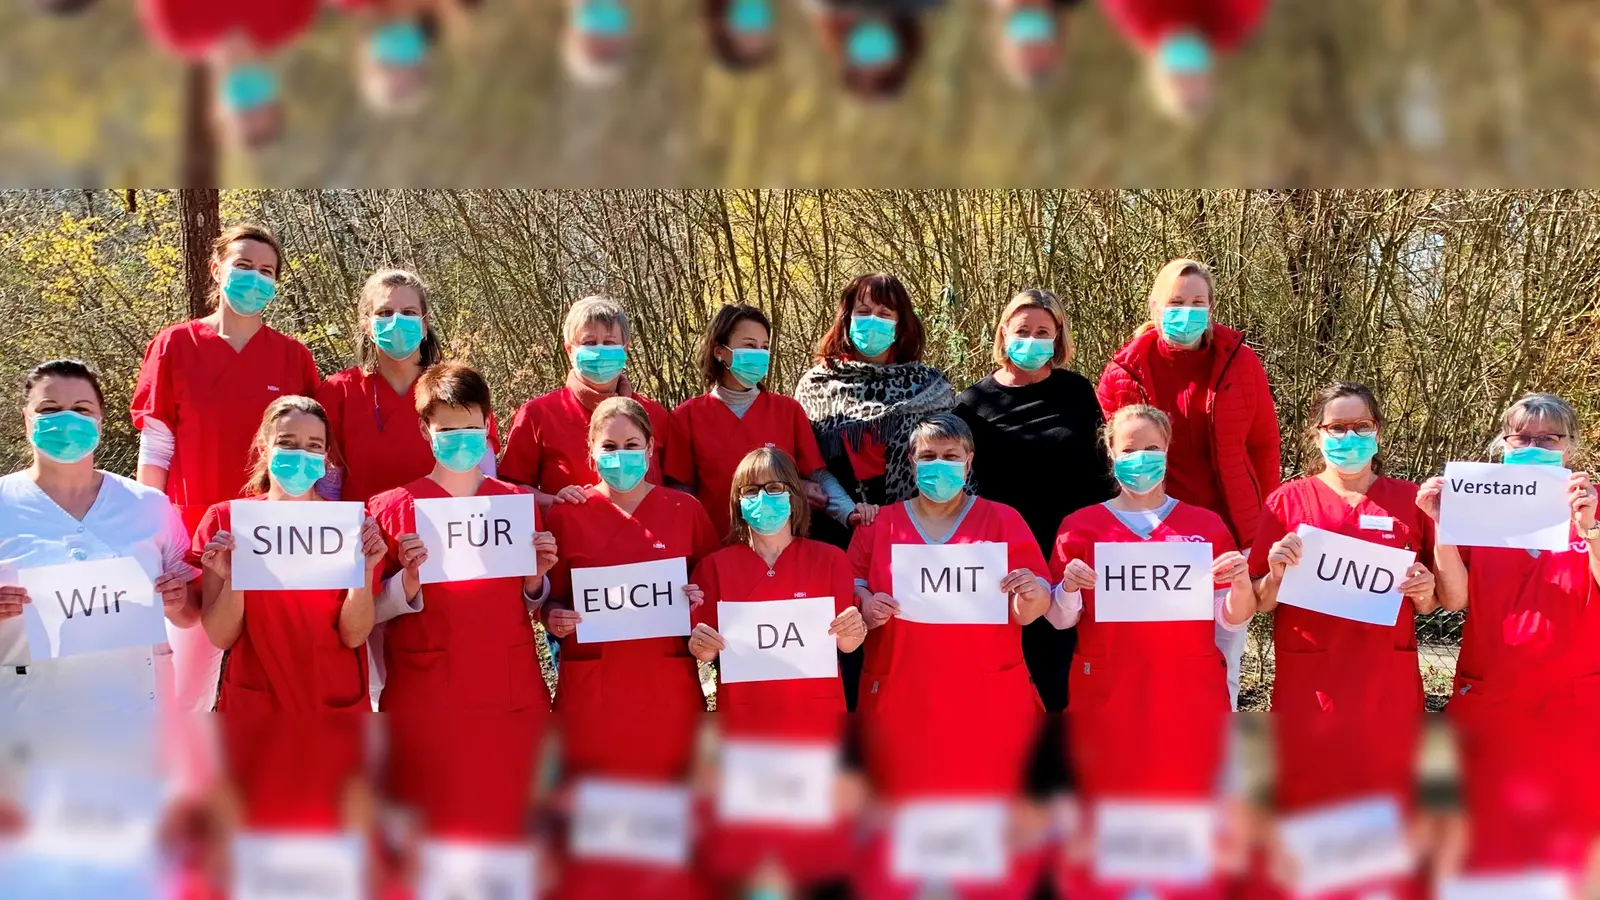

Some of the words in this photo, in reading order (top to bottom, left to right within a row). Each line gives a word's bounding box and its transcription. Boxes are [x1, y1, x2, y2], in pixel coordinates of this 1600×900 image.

[1450, 478, 1537, 496] Verstand
[252, 525, 343, 555] SIND
[447, 514, 512, 548] FÜR
[920, 565, 984, 593] MIT
[1104, 564, 1192, 592] HERZ
[1316, 552, 1395, 595] UND
[55, 584, 127, 619] Wir
[582, 580, 673, 613] EUCH
[757, 622, 805, 650] DA
